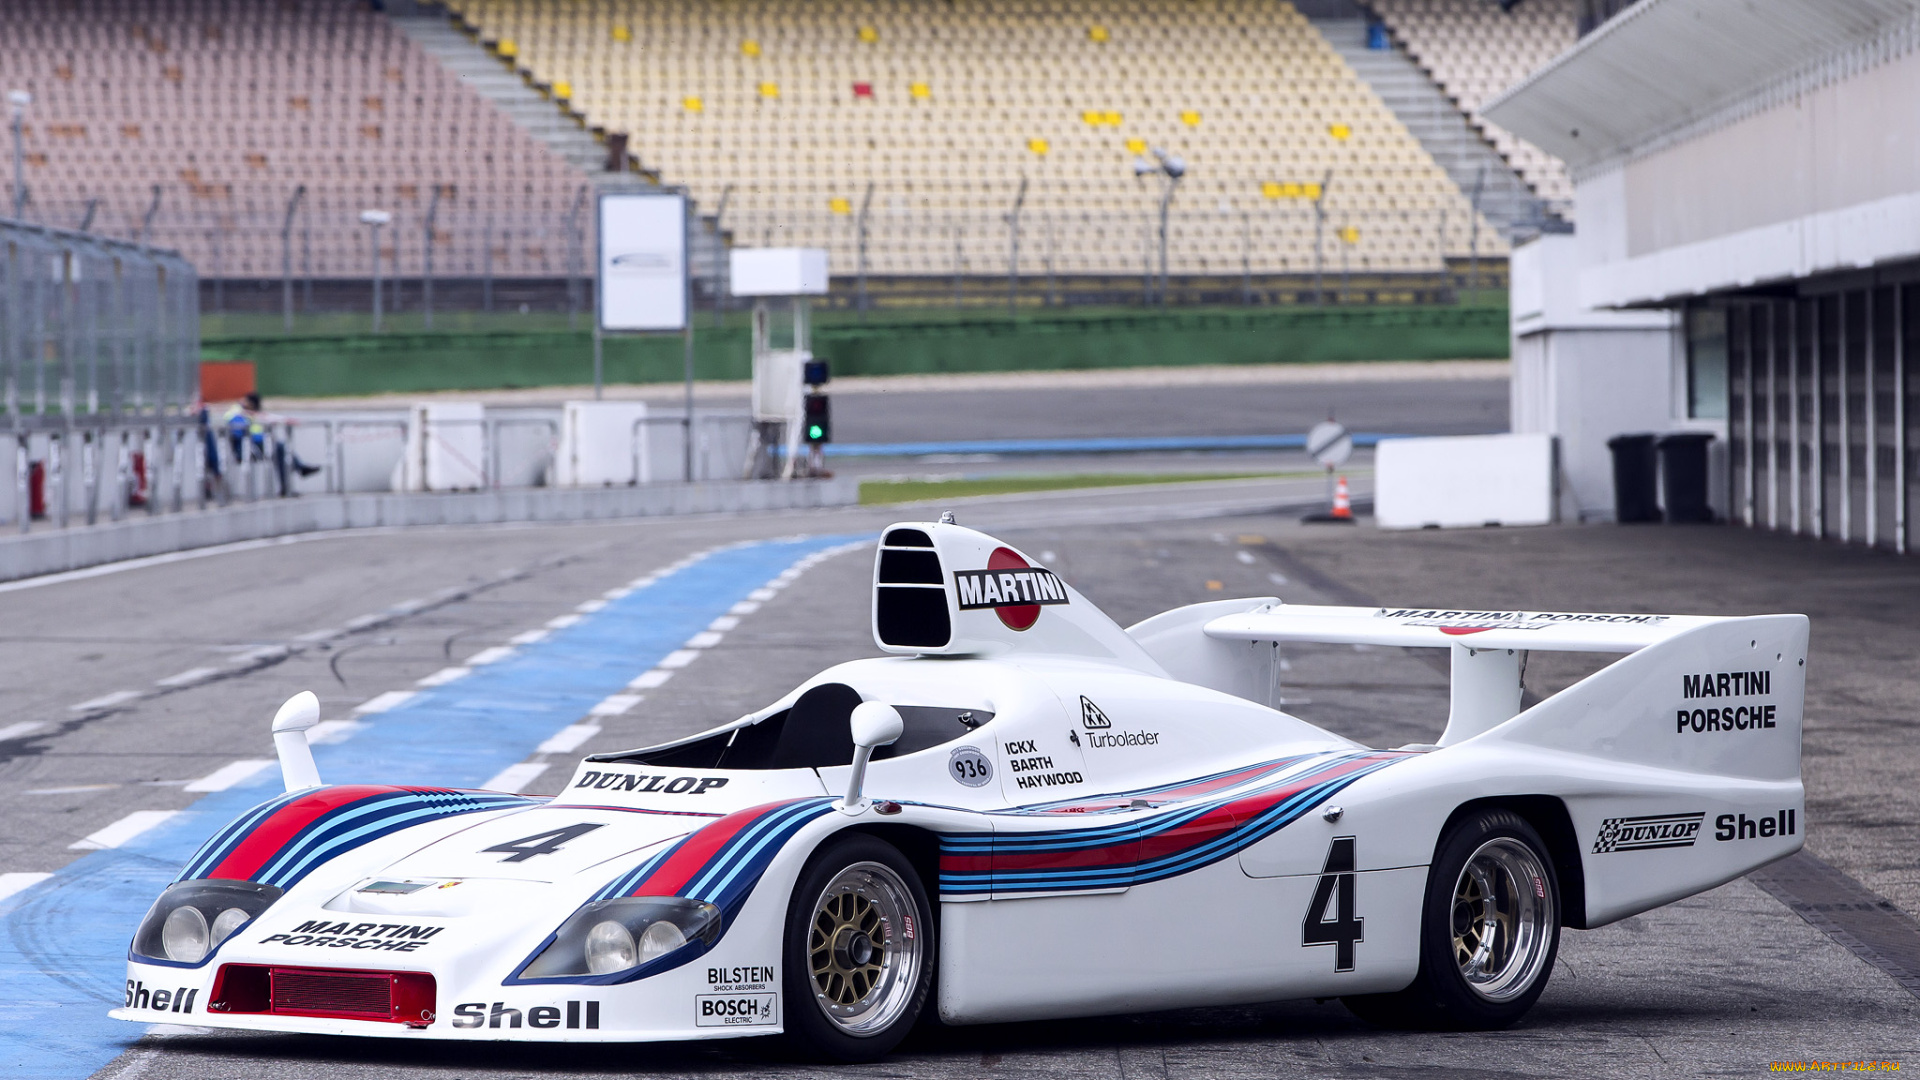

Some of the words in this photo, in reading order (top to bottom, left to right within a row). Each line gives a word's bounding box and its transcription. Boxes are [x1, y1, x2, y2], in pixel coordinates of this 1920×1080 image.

[957, 572, 1065, 606] MARTINI
[1683, 670, 1771, 699] MARTINI
[1676, 705, 1777, 733] PORSCHE
[1004, 739, 1038, 755] ICKX
[1085, 730, 1159, 748] Turbolader
[955, 758, 987, 779] 936
[1010, 756, 1054, 772] BARTH
[574, 770, 730, 795] DUNLOP
[1016, 771, 1083, 789] HAYWOOD
[1618, 822, 1701, 842] DUNLOP
[1715, 808, 1796, 842] Shell
[476, 822, 610, 864] 4
[1302, 835, 1364, 973] 4
[290, 919, 445, 940] MARTINI
[258, 933, 430, 952] PORSCHE
[708, 966, 774, 984] BILSTEIN
[125, 979, 200, 1014] Shell
[452, 1000, 600, 1030] Shell
[702, 999, 758, 1016] BOSCH
[724, 1016, 753, 1024] ELECTRIC
